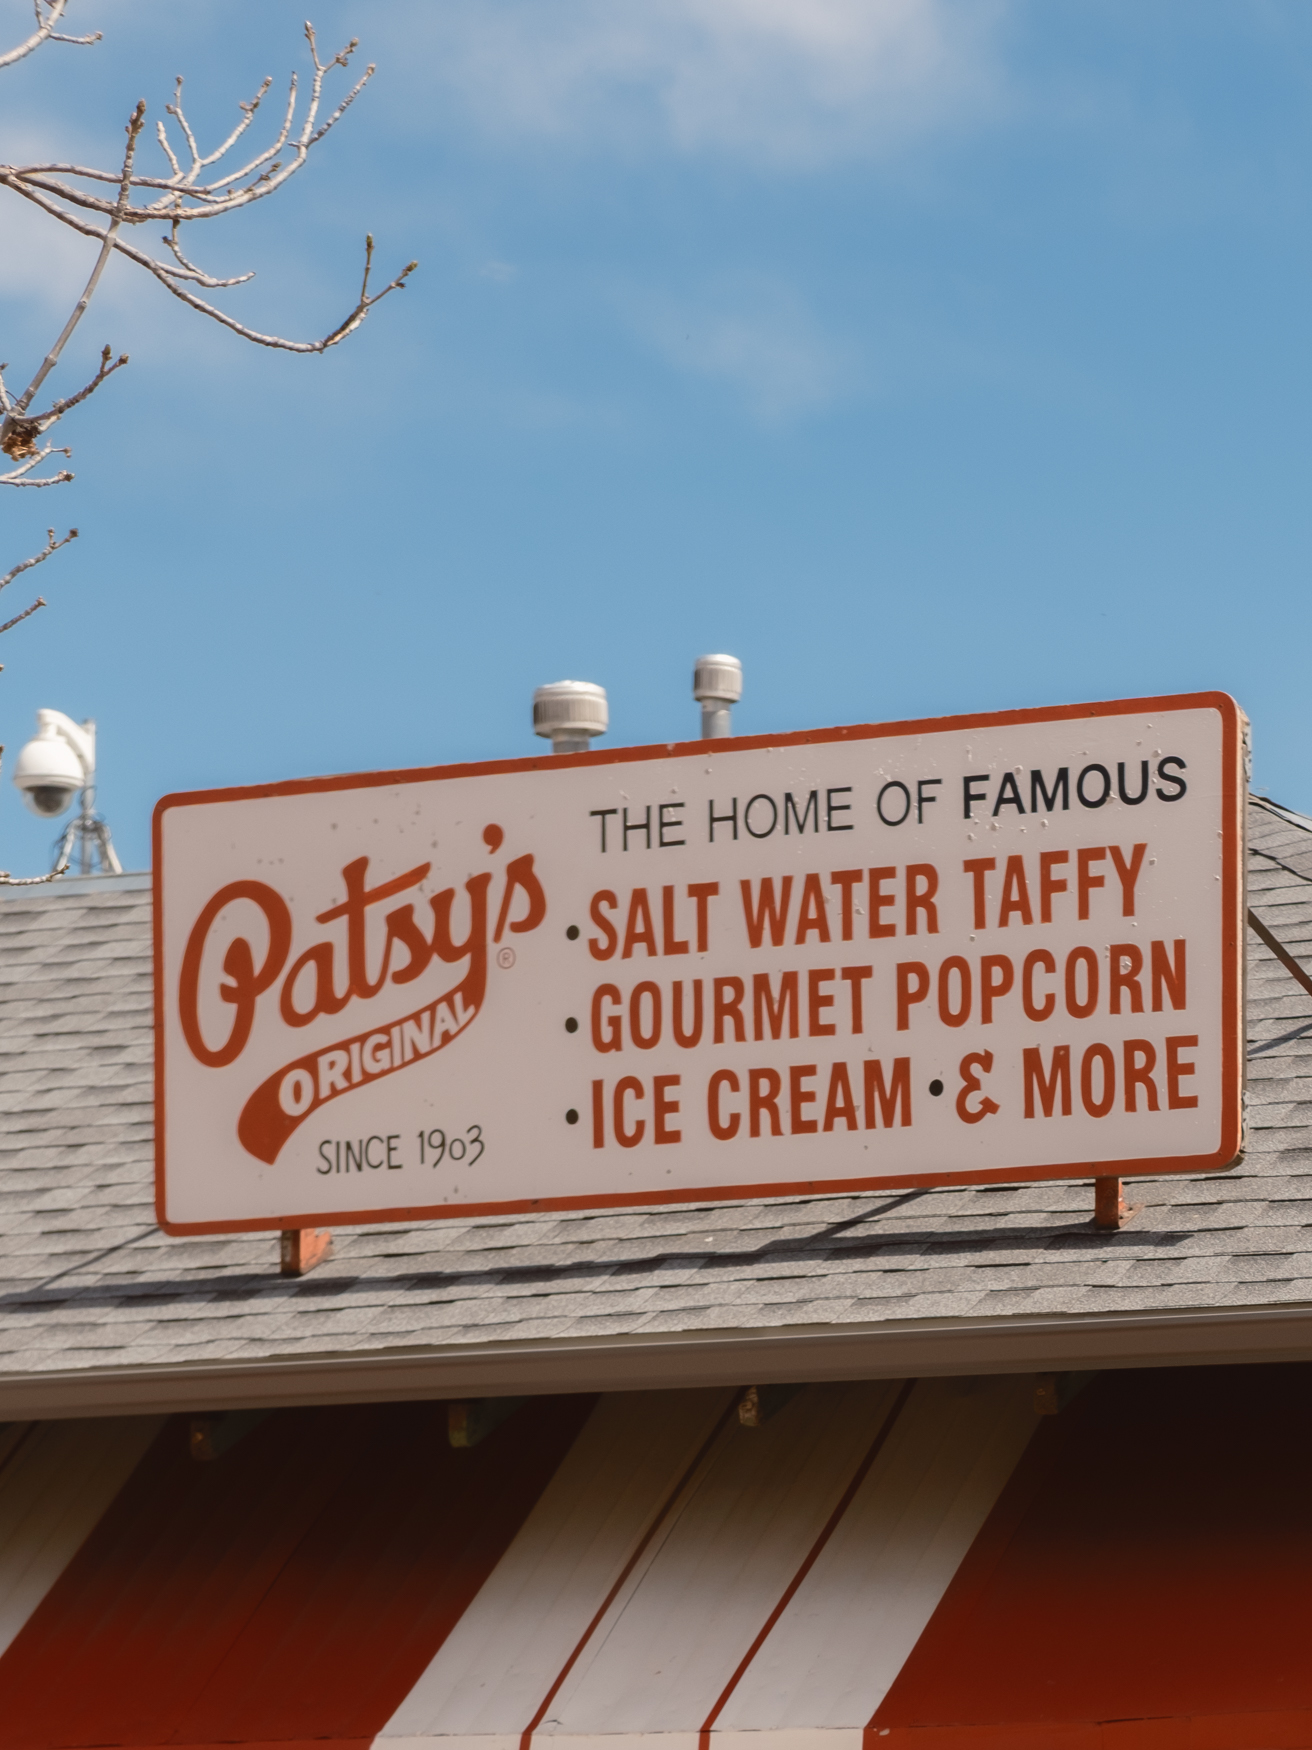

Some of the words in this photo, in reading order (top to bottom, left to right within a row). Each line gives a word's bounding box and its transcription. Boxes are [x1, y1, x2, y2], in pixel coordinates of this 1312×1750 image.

[590, 802, 685, 853] THE
[708, 786, 854, 843] HOME
[877, 778, 943, 827] OF
[962, 755, 1188, 820] FAMOUS
[178, 822, 547, 1068] Patsy's
[588, 881, 719, 961] SALT
[740, 862, 939, 949] WATER
[963, 842, 1148, 930] TAFFY
[590, 965, 873, 1053] GOURMET
[896, 938, 1187, 1032] POPCORN
[278, 990, 477, 1117] ORIGINAL
[591, 1074, 682, 1149] ICE
[707, 1057, 913, 1141] CREAM
[955, 1048, 1001, 1125] &
[1022, 1034, 1199, 1119] MORE
[316, 1134, 403, 1175] SINCE
[417, 1124, 486, 1169] 1903
